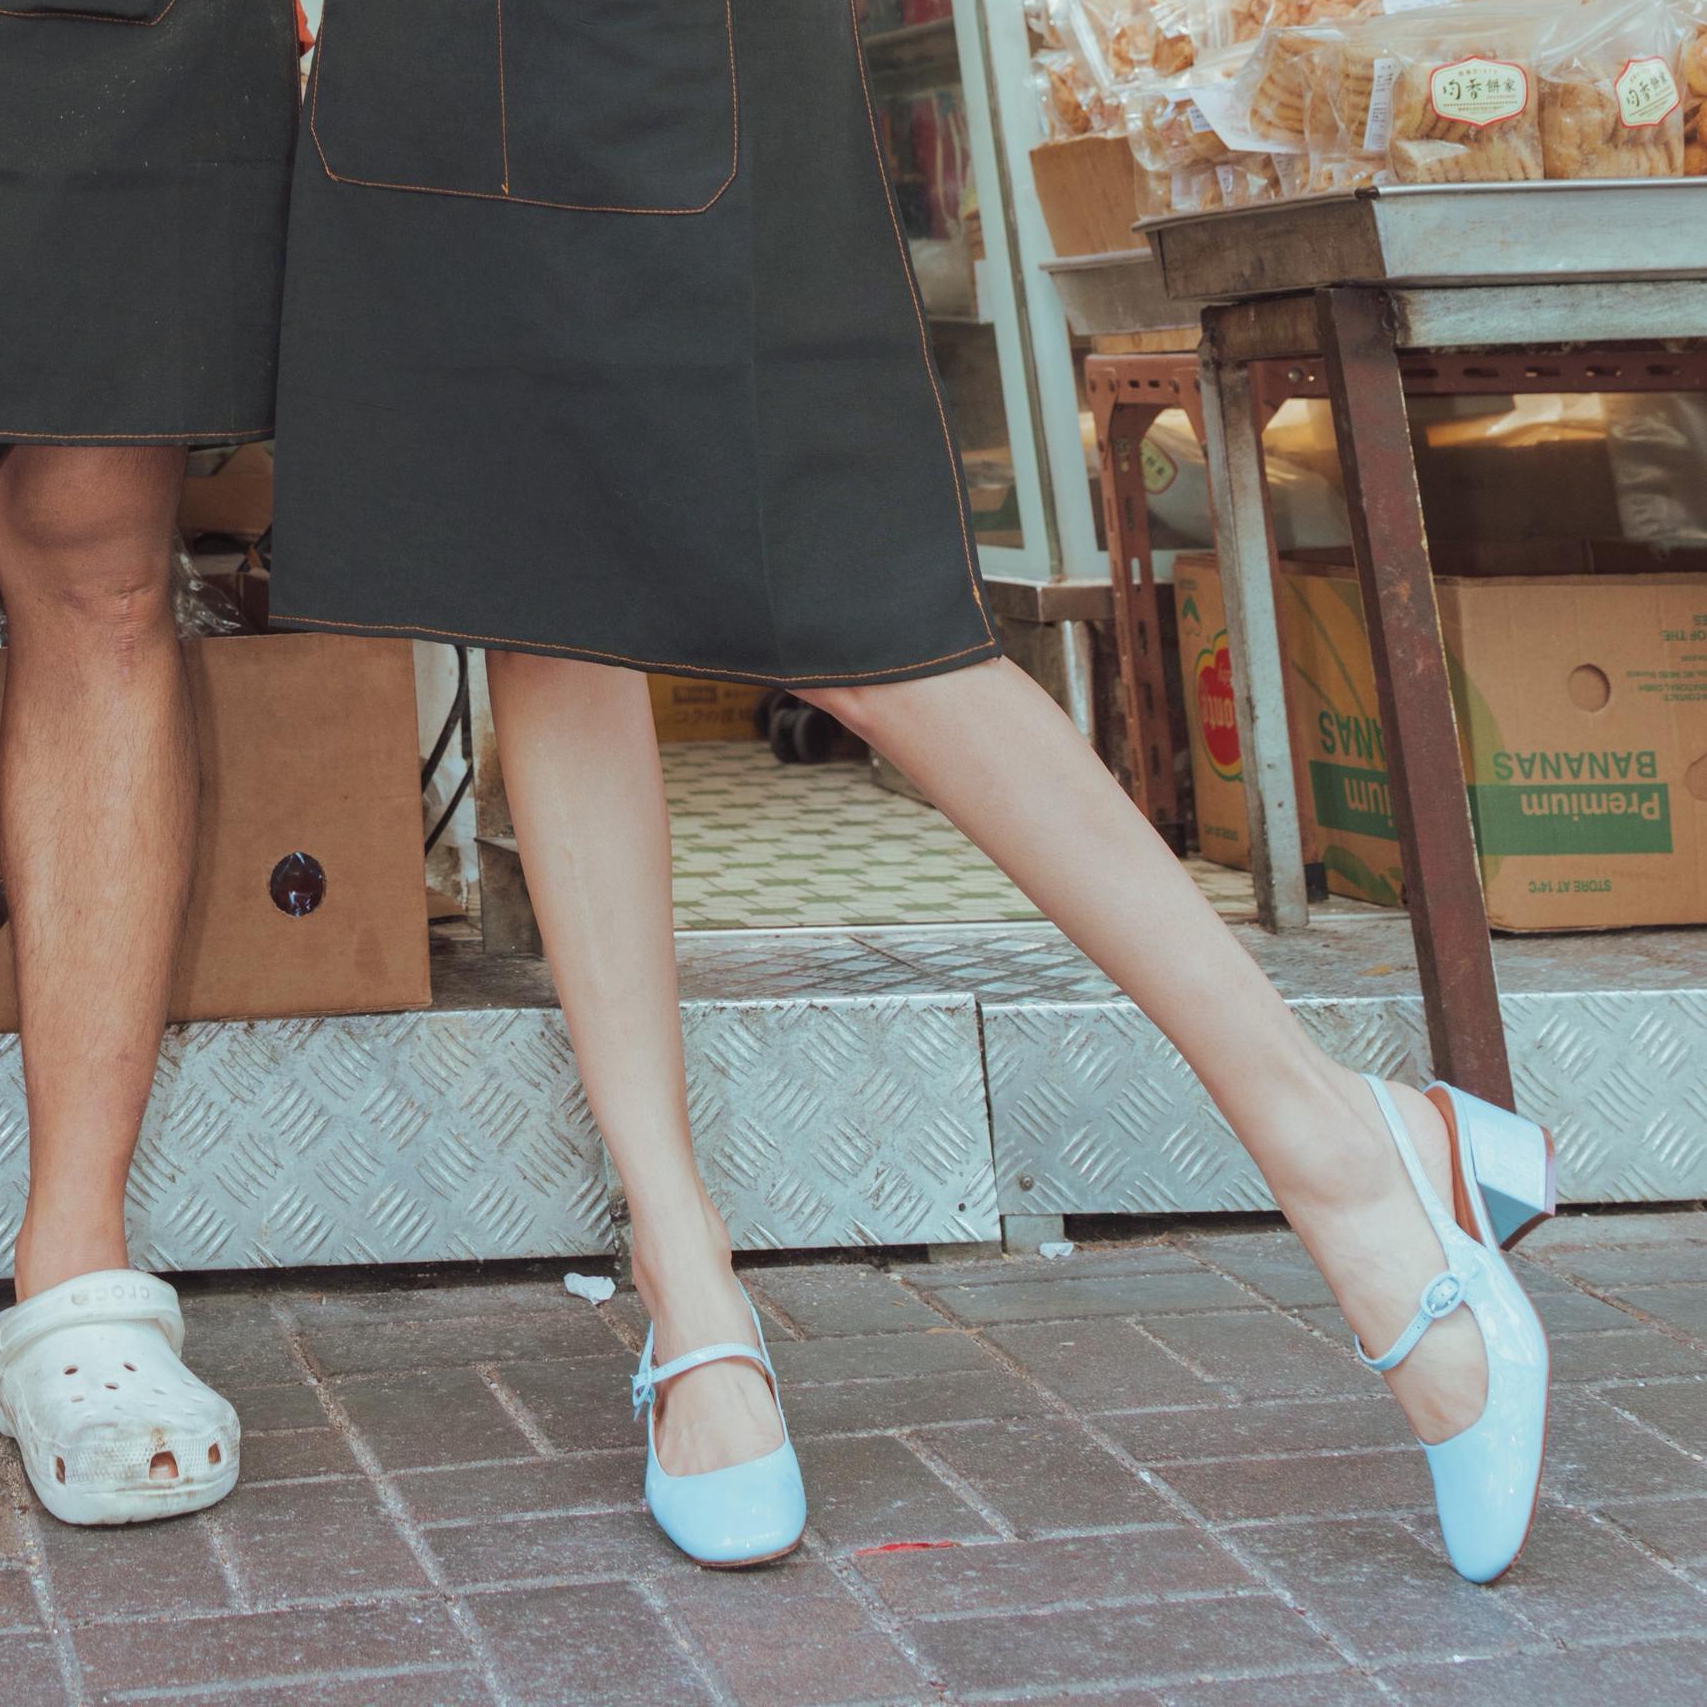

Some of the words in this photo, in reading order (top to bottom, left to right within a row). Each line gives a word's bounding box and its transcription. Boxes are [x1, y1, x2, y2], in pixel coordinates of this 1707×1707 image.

[1443, 78, 1516, 100] 均香餅家
[1494, 750, 1658, 780] BANANAS
[1521, 792, 1661, 822] Premium
[1574, 878, 1612, 893] STORE
